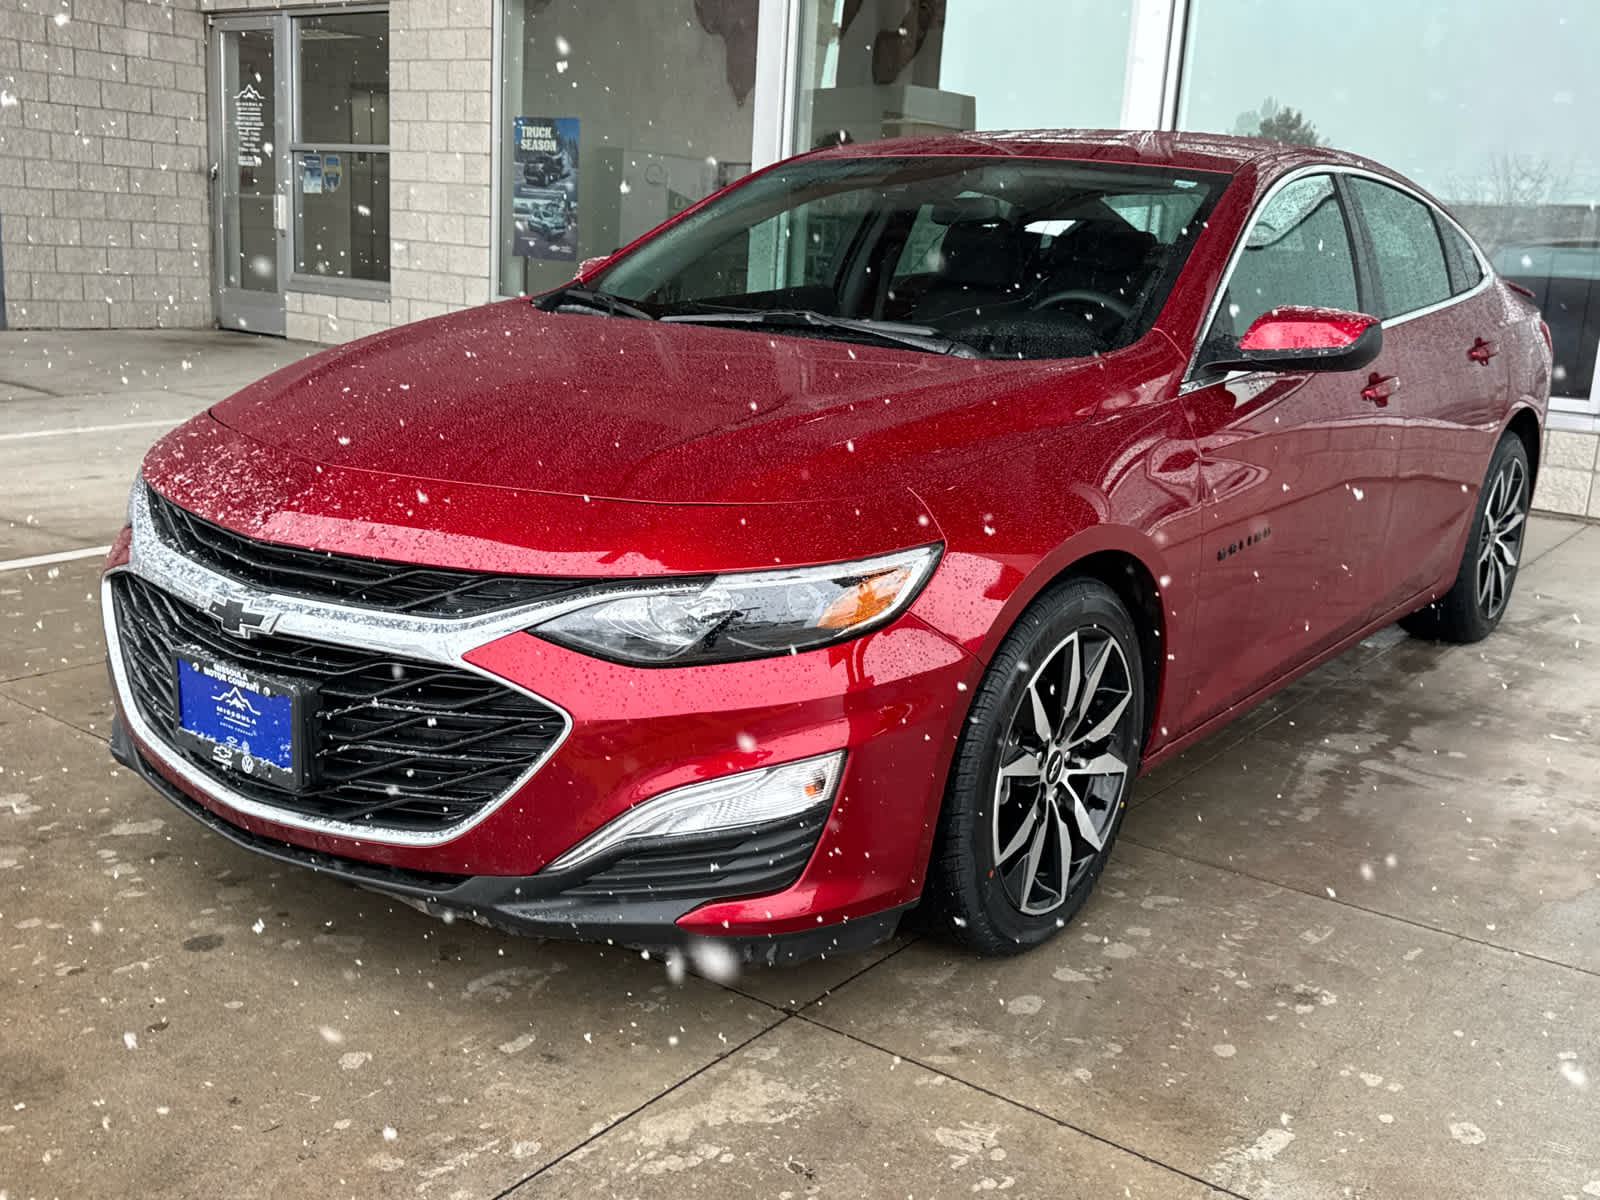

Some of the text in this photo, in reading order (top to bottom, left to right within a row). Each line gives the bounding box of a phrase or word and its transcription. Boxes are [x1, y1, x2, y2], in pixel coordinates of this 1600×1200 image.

[521, 126, 552, 138] TRUCK
[520, 139, 557, 152] SEASON
[203, 667, 260, 694] MOTOR COMPANY
[213, 663, 248, 681] MISSOULA
[216, 705, 257, 725] MISSOULA
